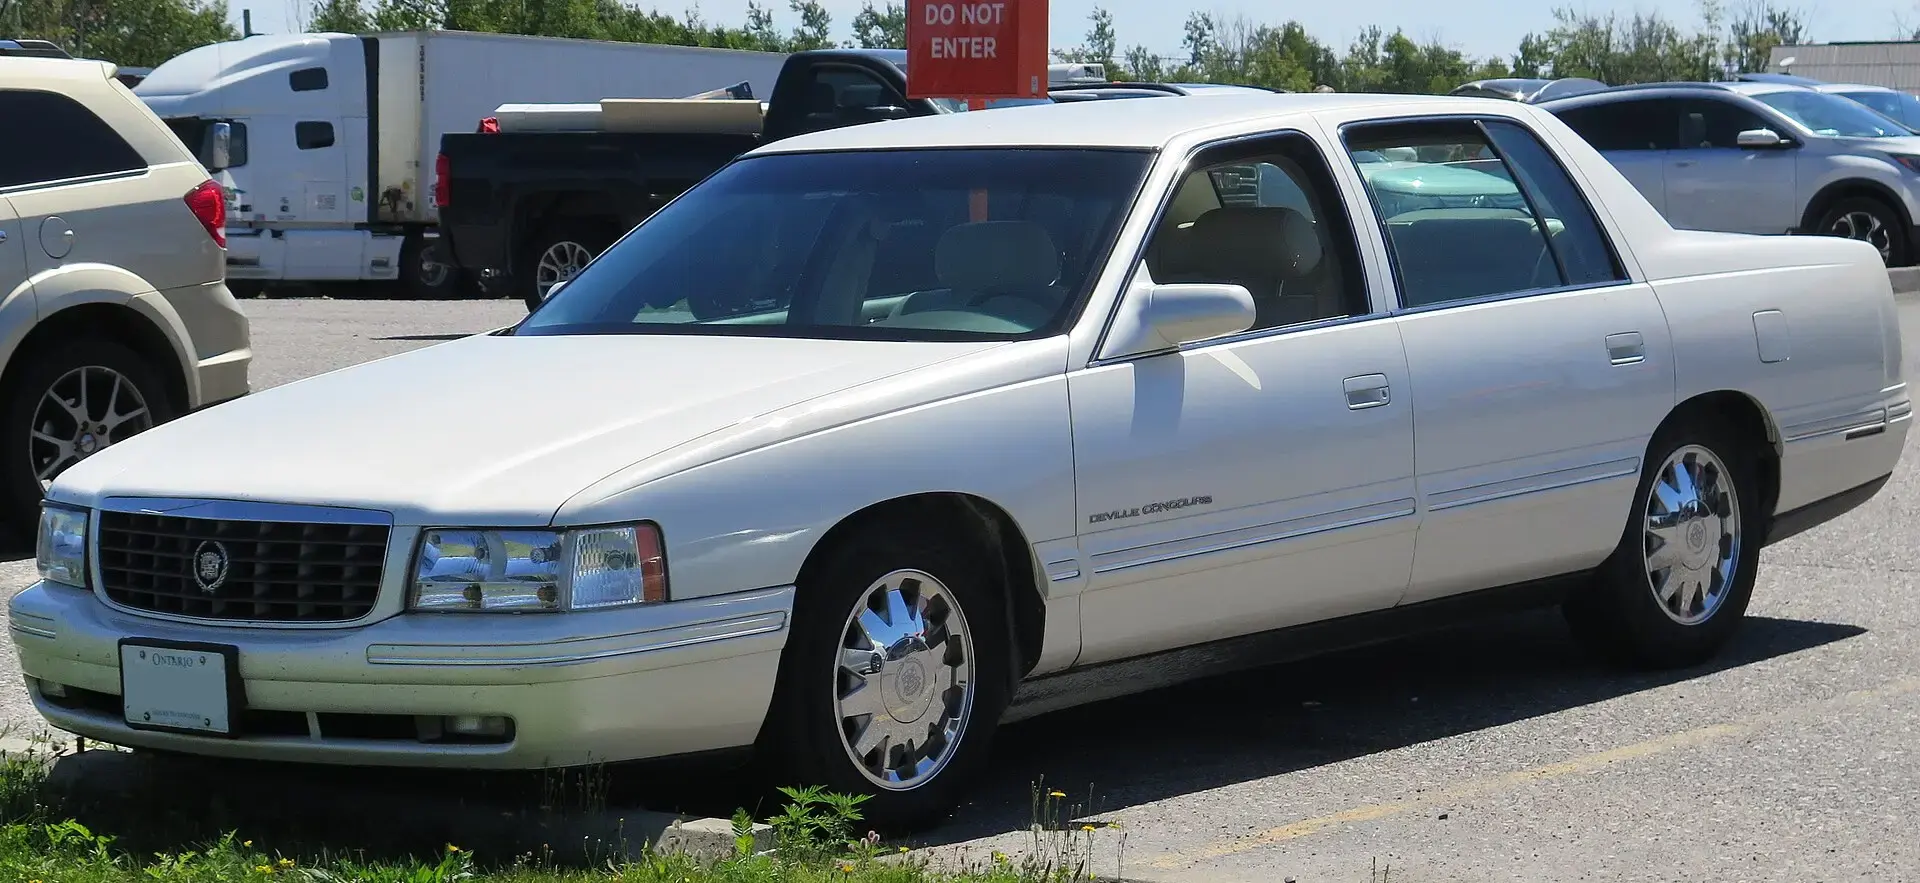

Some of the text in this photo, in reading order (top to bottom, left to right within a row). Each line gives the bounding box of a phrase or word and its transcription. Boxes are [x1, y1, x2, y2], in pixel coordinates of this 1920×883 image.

[925, 3, 1004, 25] DO NOT
[931, 37, 997, 58] ENTER
[1089, 508, 1140, 523] DEVILLE
